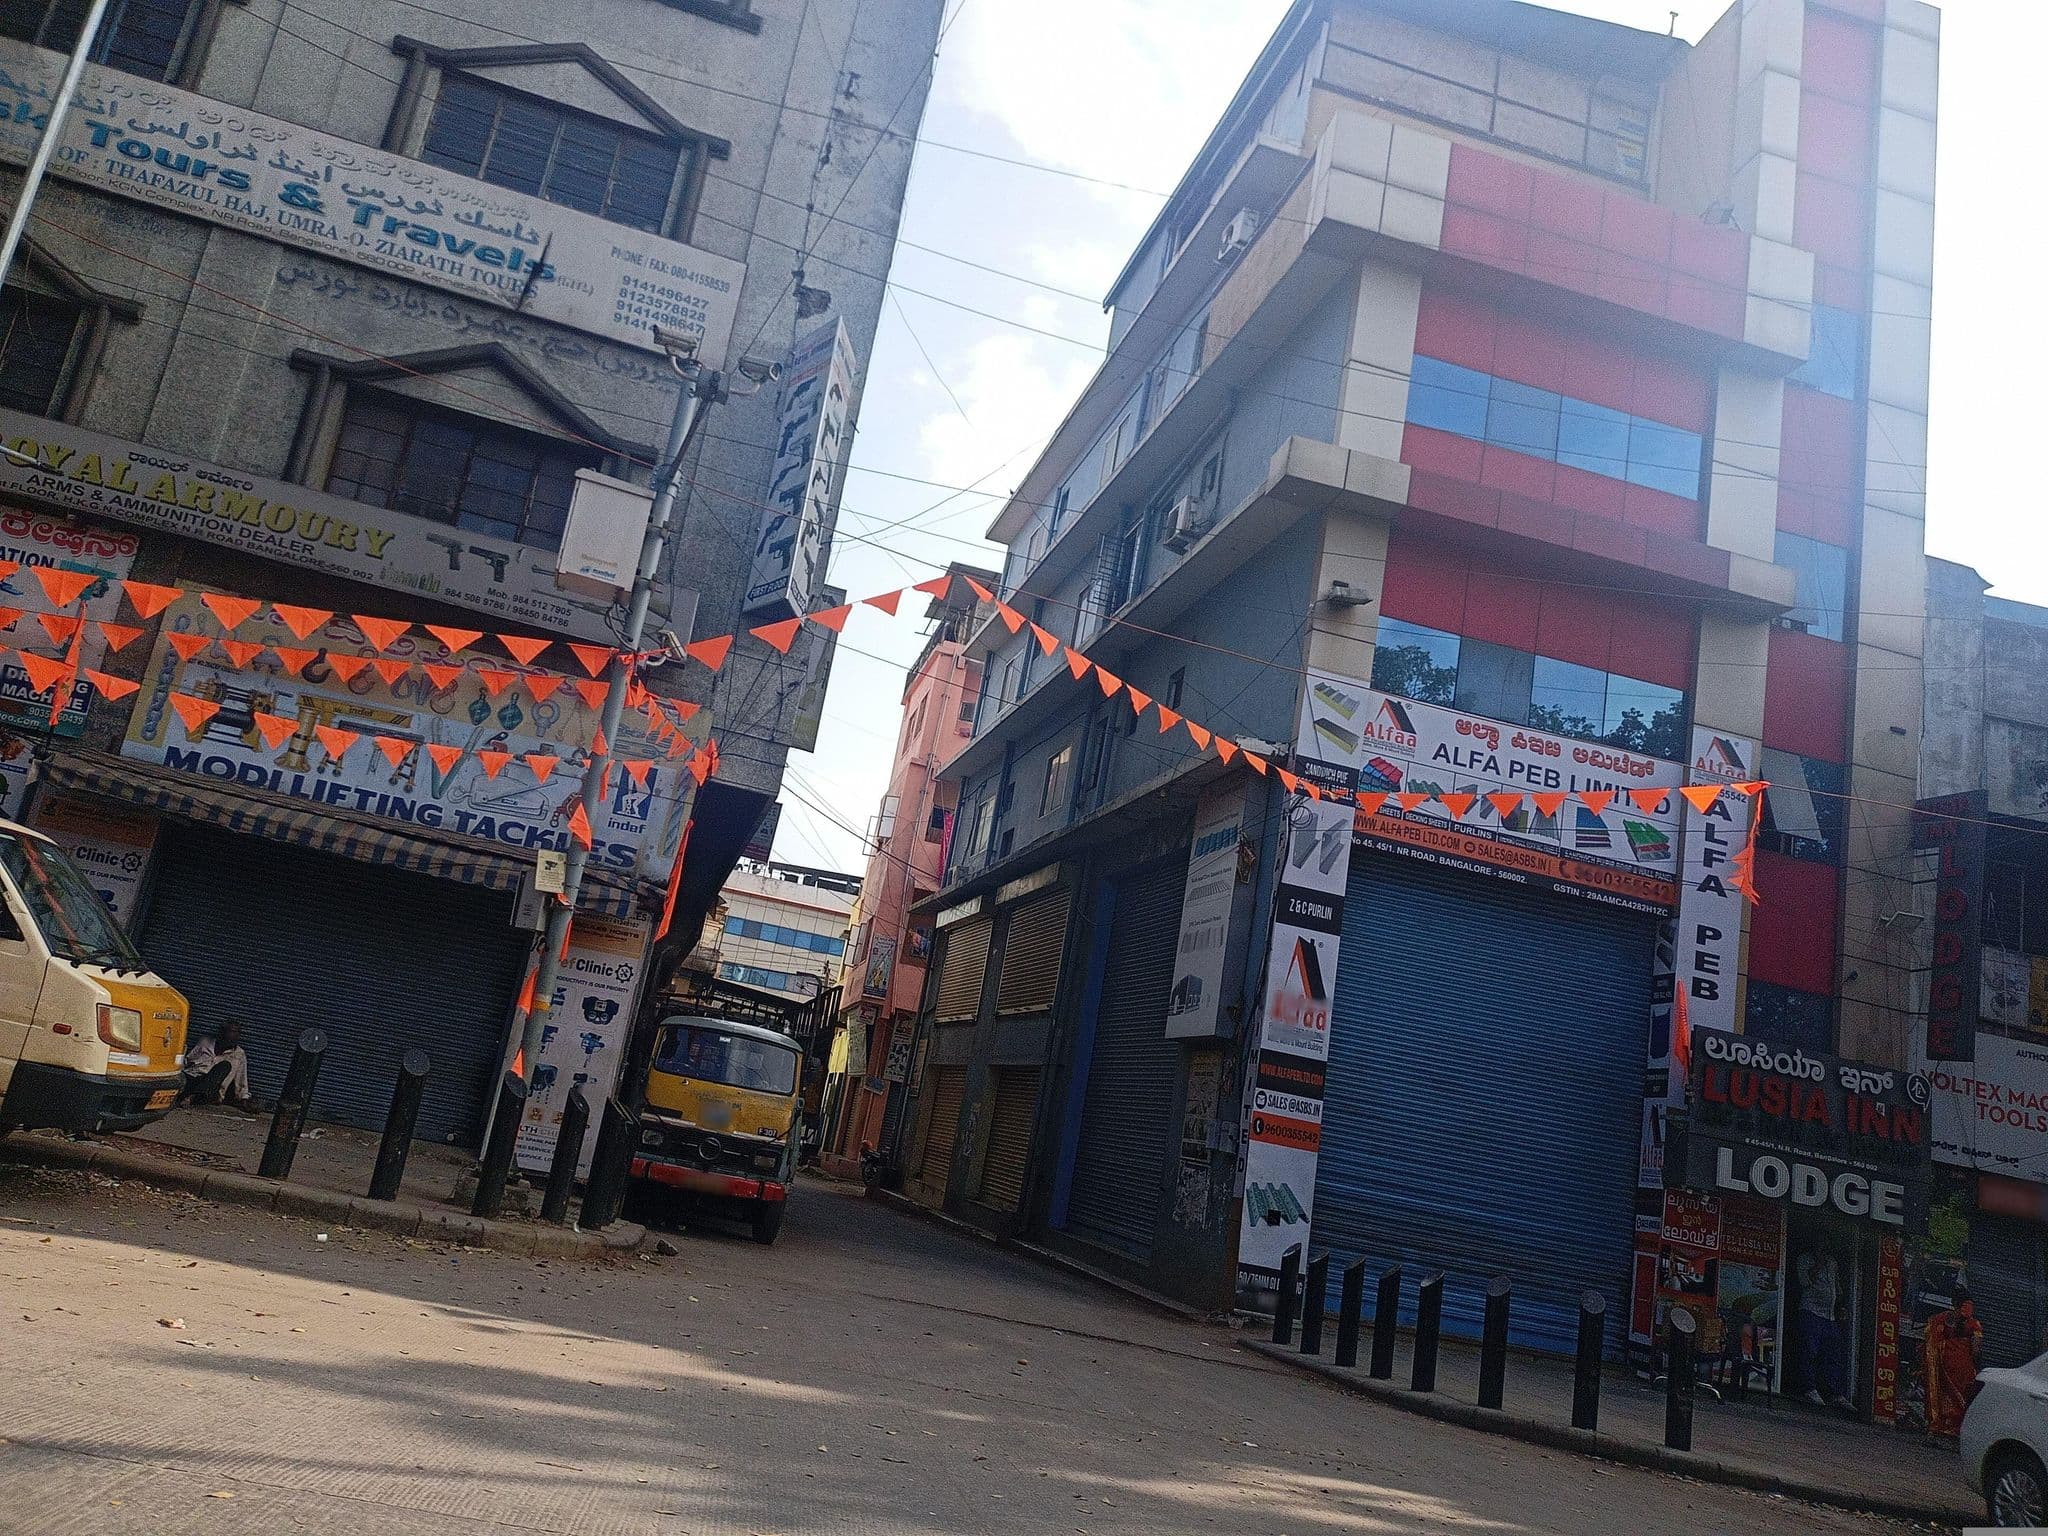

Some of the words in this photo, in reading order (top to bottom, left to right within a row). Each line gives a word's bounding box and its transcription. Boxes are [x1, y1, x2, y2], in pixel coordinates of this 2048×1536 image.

[84, 119, 251, 190] Tours
[278, 181, 326, 216] &
[346, 197, 556, 281] Travels
[105, 158, 219, 205] THAFAZUL
[277, 209, 338, 241] UMRA
[375, 239, 465, 279] ZIARATH
[0, 434, 138, 496] OYAL
[143, 472, 396, 560] ARMOURY
[26, 474, 85, 497] ARMS
[90, 490, 104, 502] &
[110, 494, 234, 534] AMMUNITION
[239, 526, 316, 556] DEALER
[163, 745, 283, 792] MODI
[289, 773, 443, 828] LIFTING
[1431, 743, 1502, 777] ALFA
[1508, 759, 1561, 790] PEB
[1569, 773, 1671, 815] LIMITD
[1397, 846, 1410, 857] NR
[1439, 856, 1492, 876] BANGALORE
[1453, 823, 1493, 840] PURLINS
[1696, 799, 1733, 899] ALFA
[1308, 902, 1333, 921] PURLIN
[1552, 882, 1580, 897] GSTIN
[1691, 923, 1723, 1001] PEB
[1704, 1035, 1826, 1082] ಲೂಸಿಯಾ
[1839, 1065, 1894, 1095] ಇನ್
[2015, 1049, 2048, 1062] AUTHO
[1703, 1064, 1832, 1128] LUSIA
[1846, 1092, 1922, 1146] INN
[1976, 1101, 2047, 1133] TOOLS
[1716, 1146, 1905, 1226] LODGE
